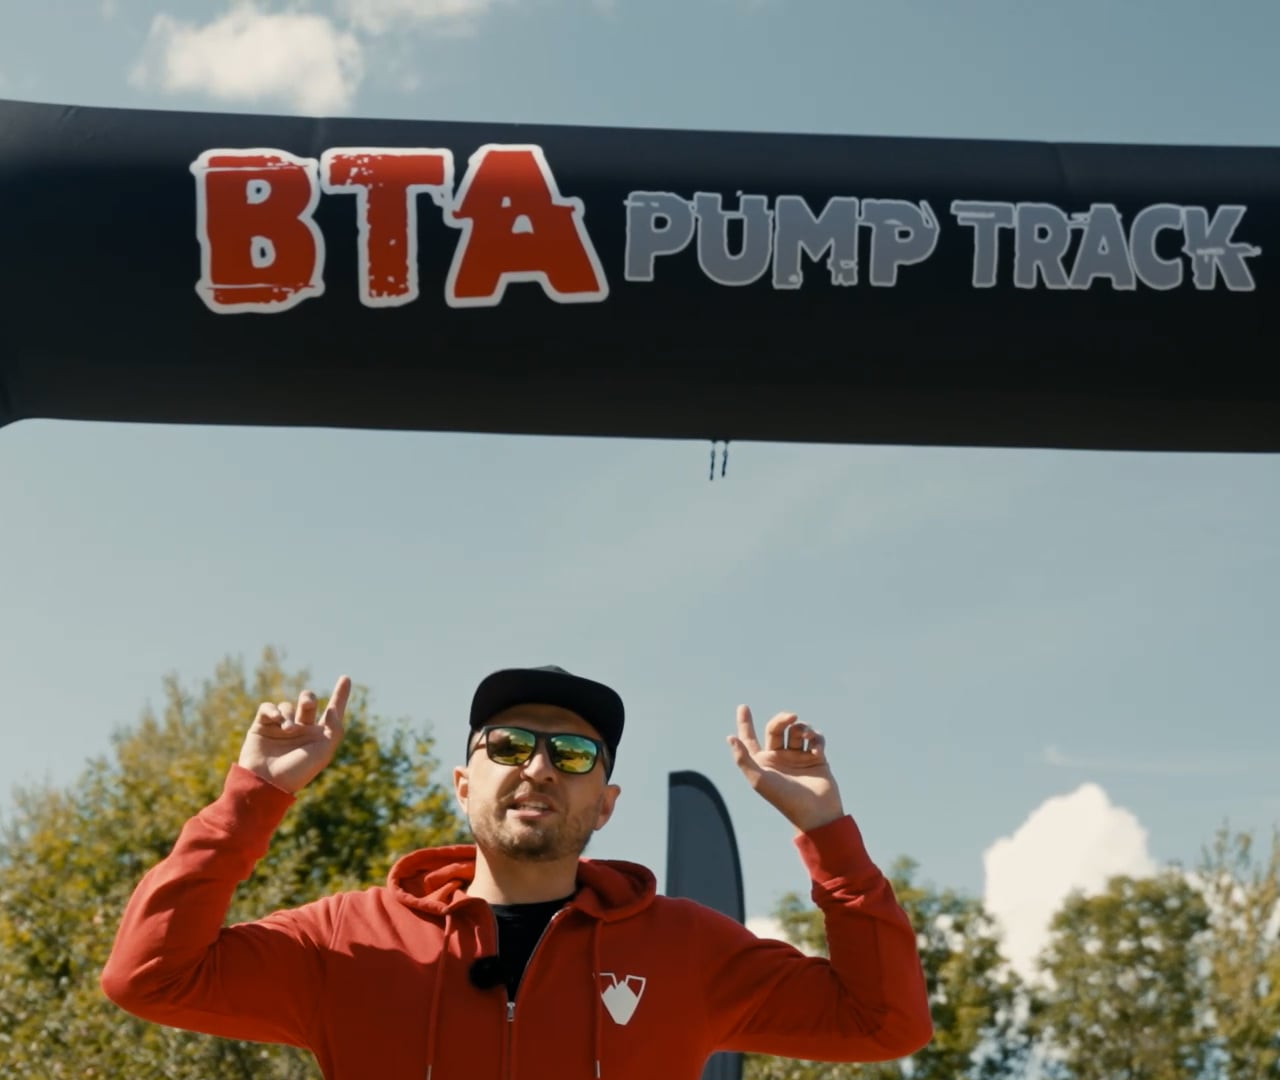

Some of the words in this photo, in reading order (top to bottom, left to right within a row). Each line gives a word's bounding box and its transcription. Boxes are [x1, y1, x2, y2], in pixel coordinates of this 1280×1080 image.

[192, 143, 609, 313] BTA
[623, 190, 939, 287] PUMP
[951, 200, 1261, 292] TRACK
